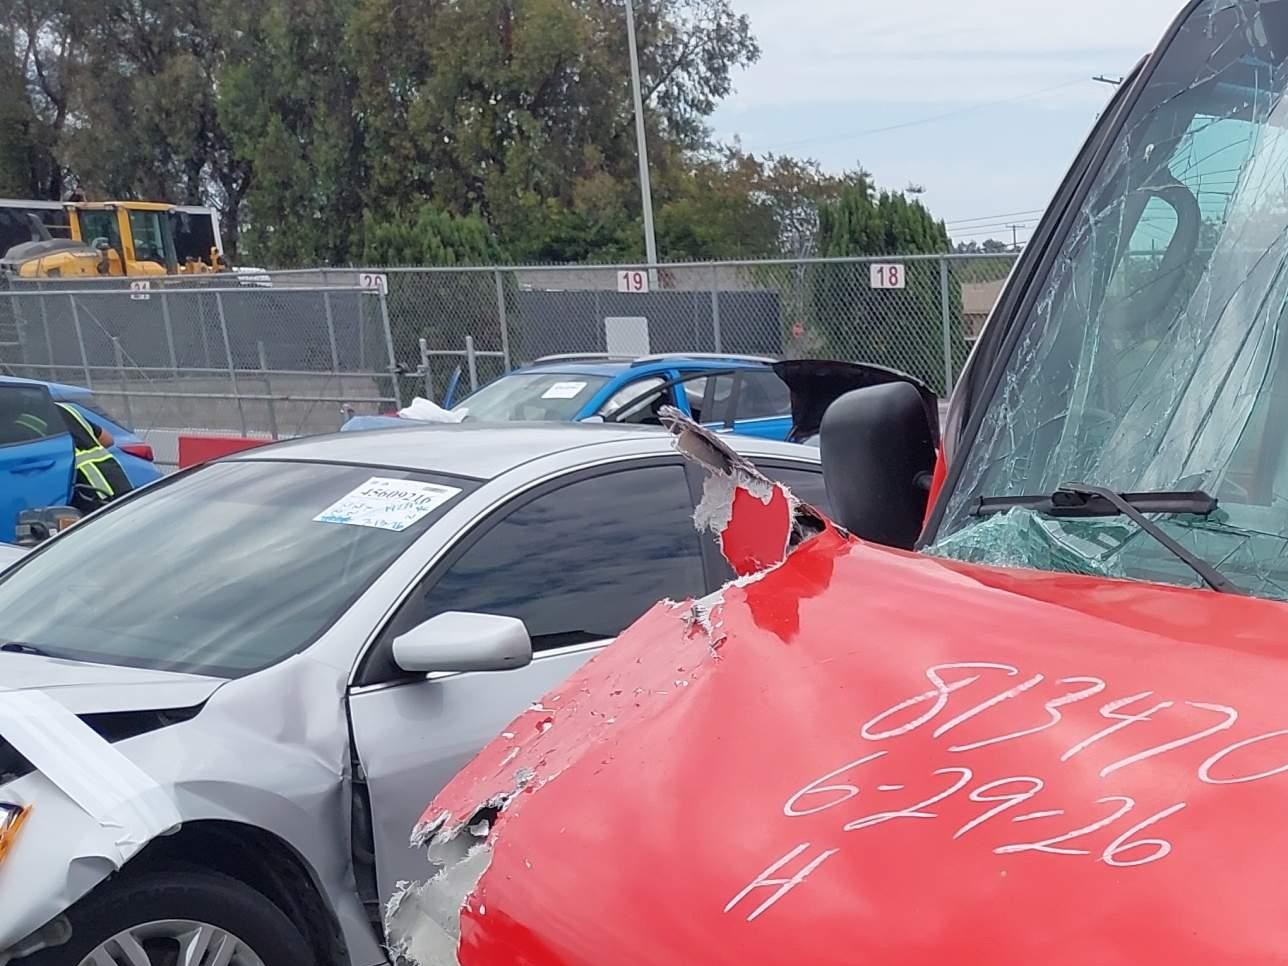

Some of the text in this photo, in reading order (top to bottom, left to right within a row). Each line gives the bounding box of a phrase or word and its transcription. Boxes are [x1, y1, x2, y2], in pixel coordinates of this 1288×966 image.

[623, 271, 643, 291] 19
[877, 266, 898, 287] 18
[784, 751, 1186, 866] 6-29-26
